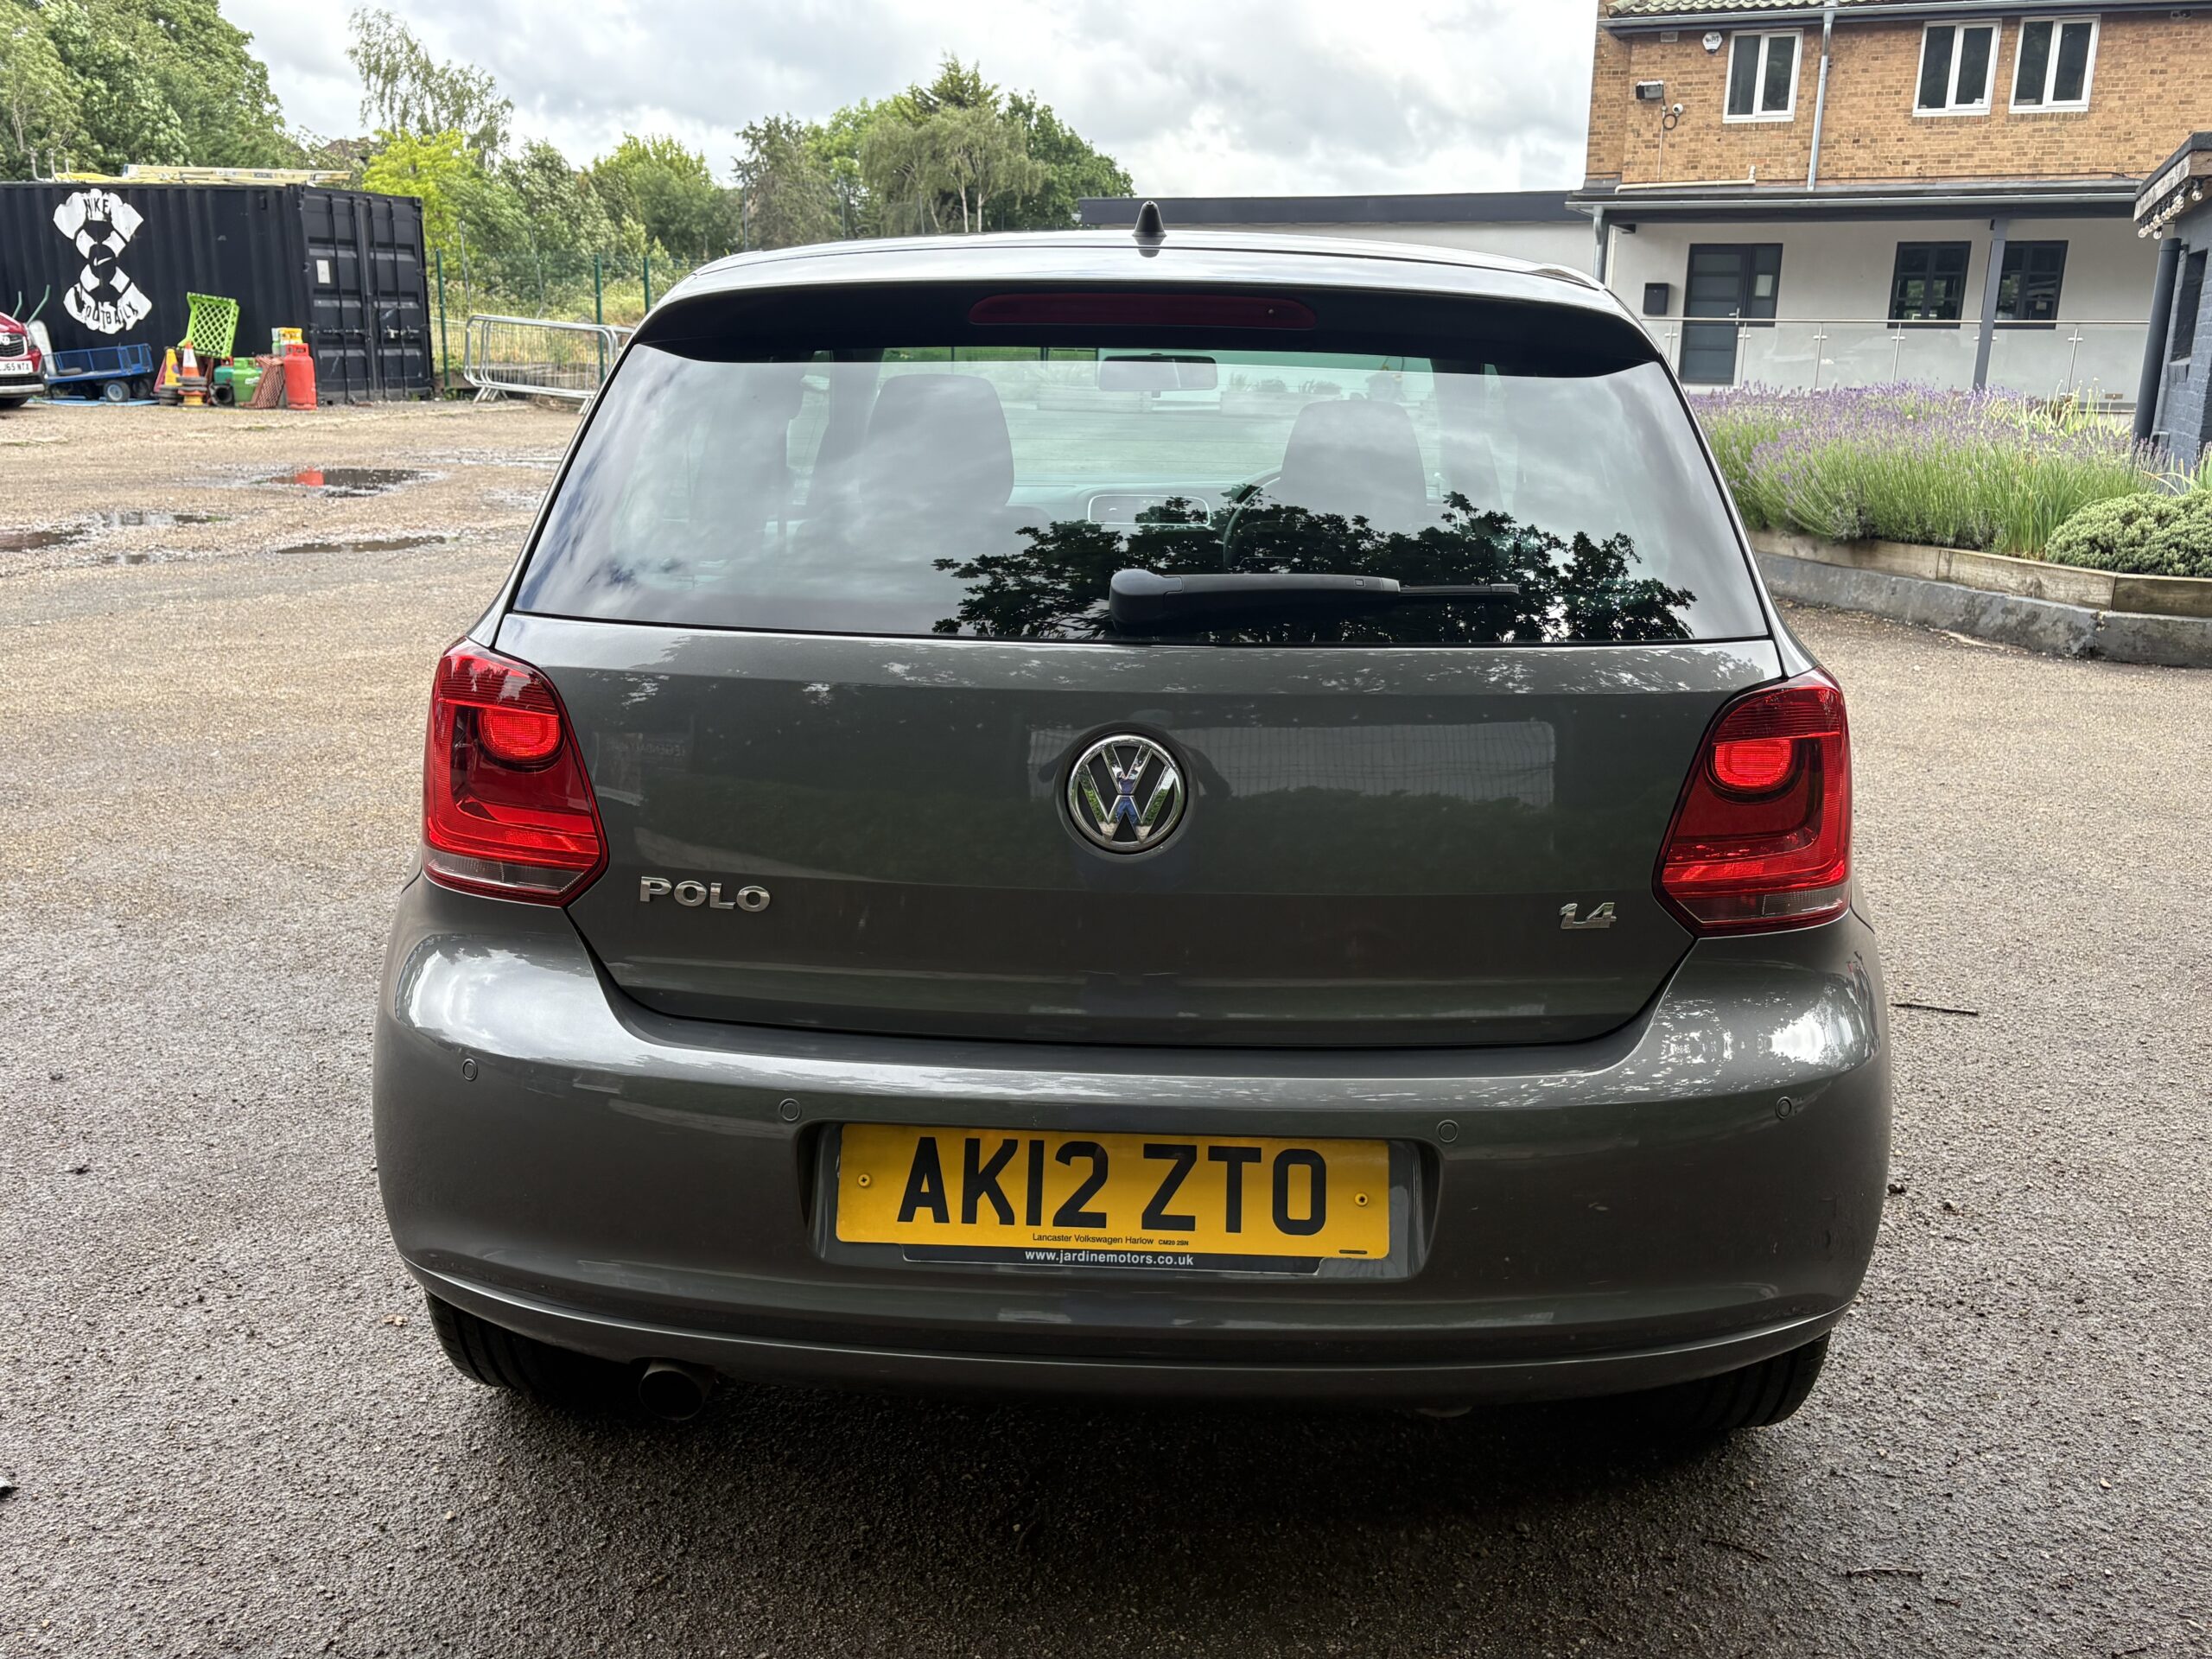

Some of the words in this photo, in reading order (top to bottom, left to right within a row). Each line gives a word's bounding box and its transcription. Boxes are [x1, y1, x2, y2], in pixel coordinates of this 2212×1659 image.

[1069, 735, 1185, 849] VW
[639, 875, 771, 912] POLO
[1559, 902, 1618, 930] 1.4
[896, 1136, 1109, 1229] AK12
[1141, 1142, 1327, 1236] ZTO
[1033, 1232, 1072, 1243] Lancaster
[1074, 1234, 1123, 1245] Volkswagen
[1125, 1236, 1154, 1245] Harlow
[1025, 1249, 1194, 1266] www.jardinemotors.co.uk
